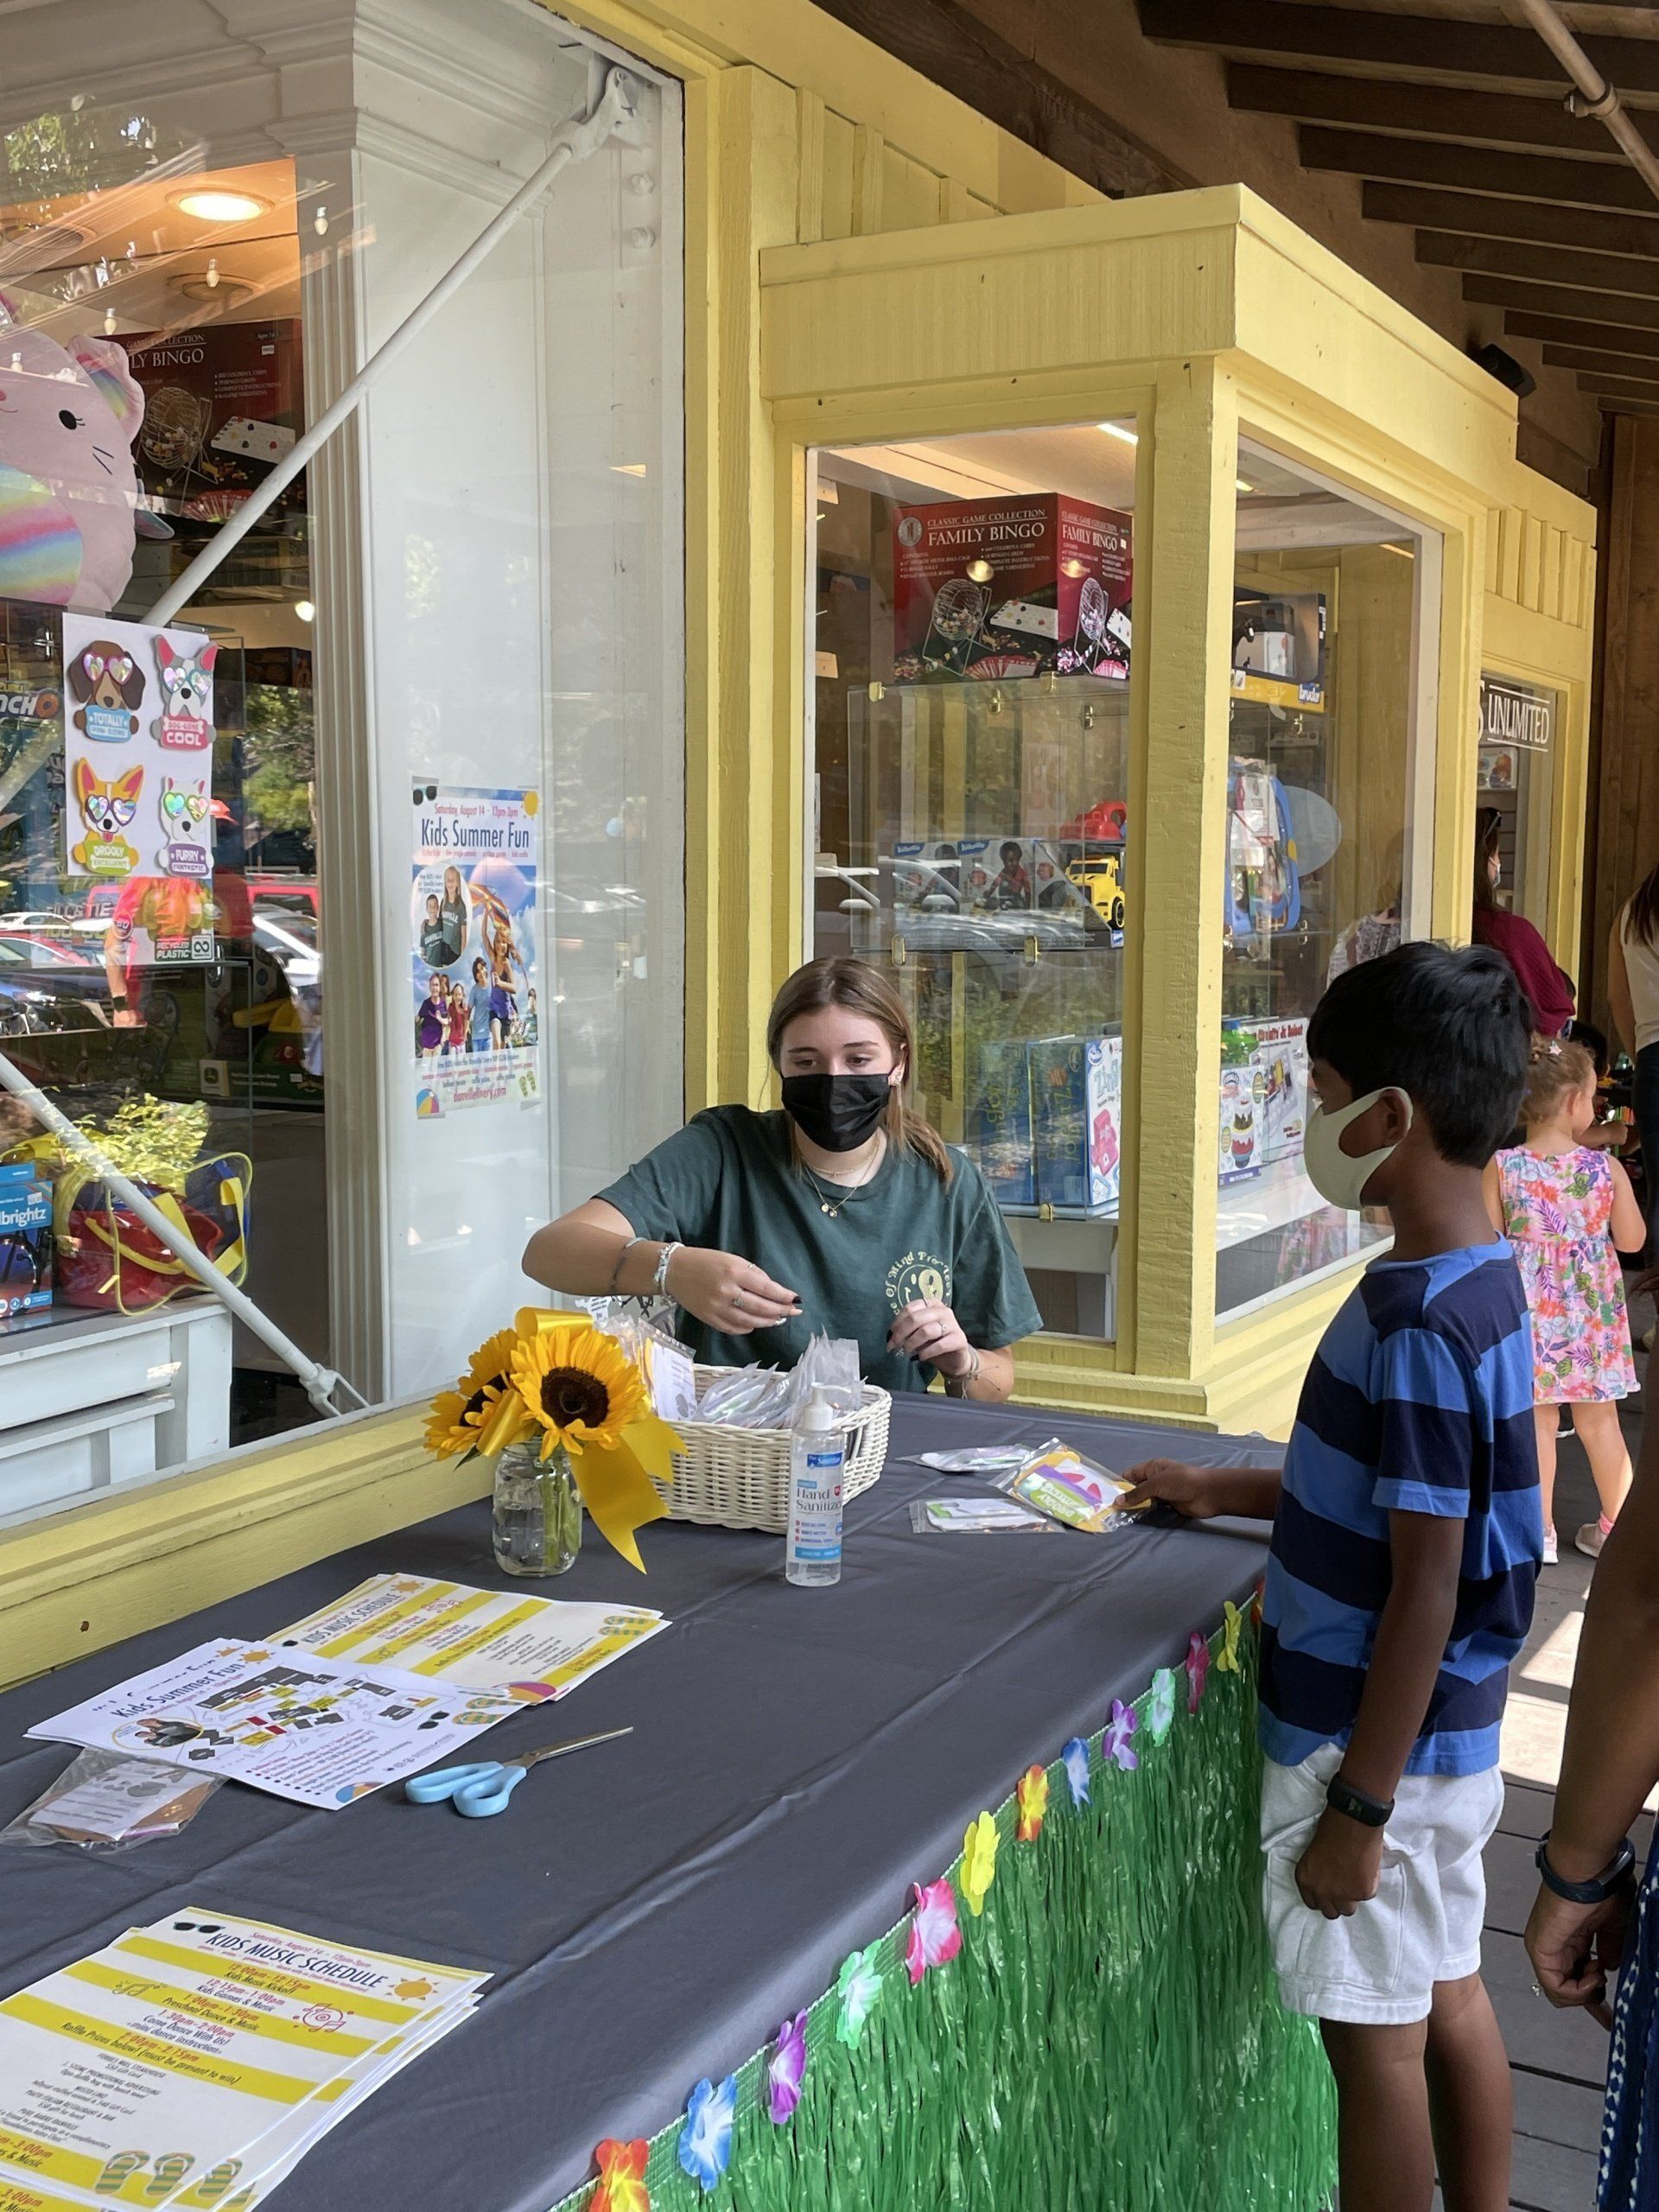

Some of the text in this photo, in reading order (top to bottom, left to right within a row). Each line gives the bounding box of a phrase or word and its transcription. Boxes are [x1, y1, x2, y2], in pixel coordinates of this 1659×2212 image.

[152, 347, 204, 366] BINGO
[927, 508, 1046, 527] CLASSIC GAME COLLECTION
[928, 522, 1046, 546] FAMILY BINGO
[1062, 524, 1118, 551] FAMILY BINGO
[92, 712, 124, 728] TOTALLY
[1488, 693, 1550, 744] UNLIMITED
[167, 732, 202, 746] COOL
[422, 817, 530, 848] Kids Summer Fun
[93, 845, 124, 857] DROOLY
[175, 849, 199, 862] FURRY
[156, 950, 190, 959] PLASTIC
[888, 1252, 915, 1279] Mind
[886, 1281, 897, 1298] Of
[797, 1487, 830, 1500] Hand
[301, 1630, 331, 1643] KIDS
[323, 1615, 360, 1632] MUSIC
[351, 1592, 402, 1618] SCHEDULE
[111, 1662, 245, 1718] Kids Summer Fun
[206, 1933, 390, 1988] KIDS MUSIC SCHEDULE
[224, 1971, 242, 1981] Kids
[196, 1985, 213, 1995] Kids
[214, 1990, 241, 2003] Games
[251, 1999, 276, 2012] Music
[162, 1997, 200, 2016] Preschool
[200, 2009, 227, 2022] Dance
[238, 2018, 260, 2031] Music
[61, 2021, 86, 2036] Raffle
[143, 2014, 167, 2027] Come
[168, 2022, 194, 2035] Dance
[193, 2028, 213, 2042] With
